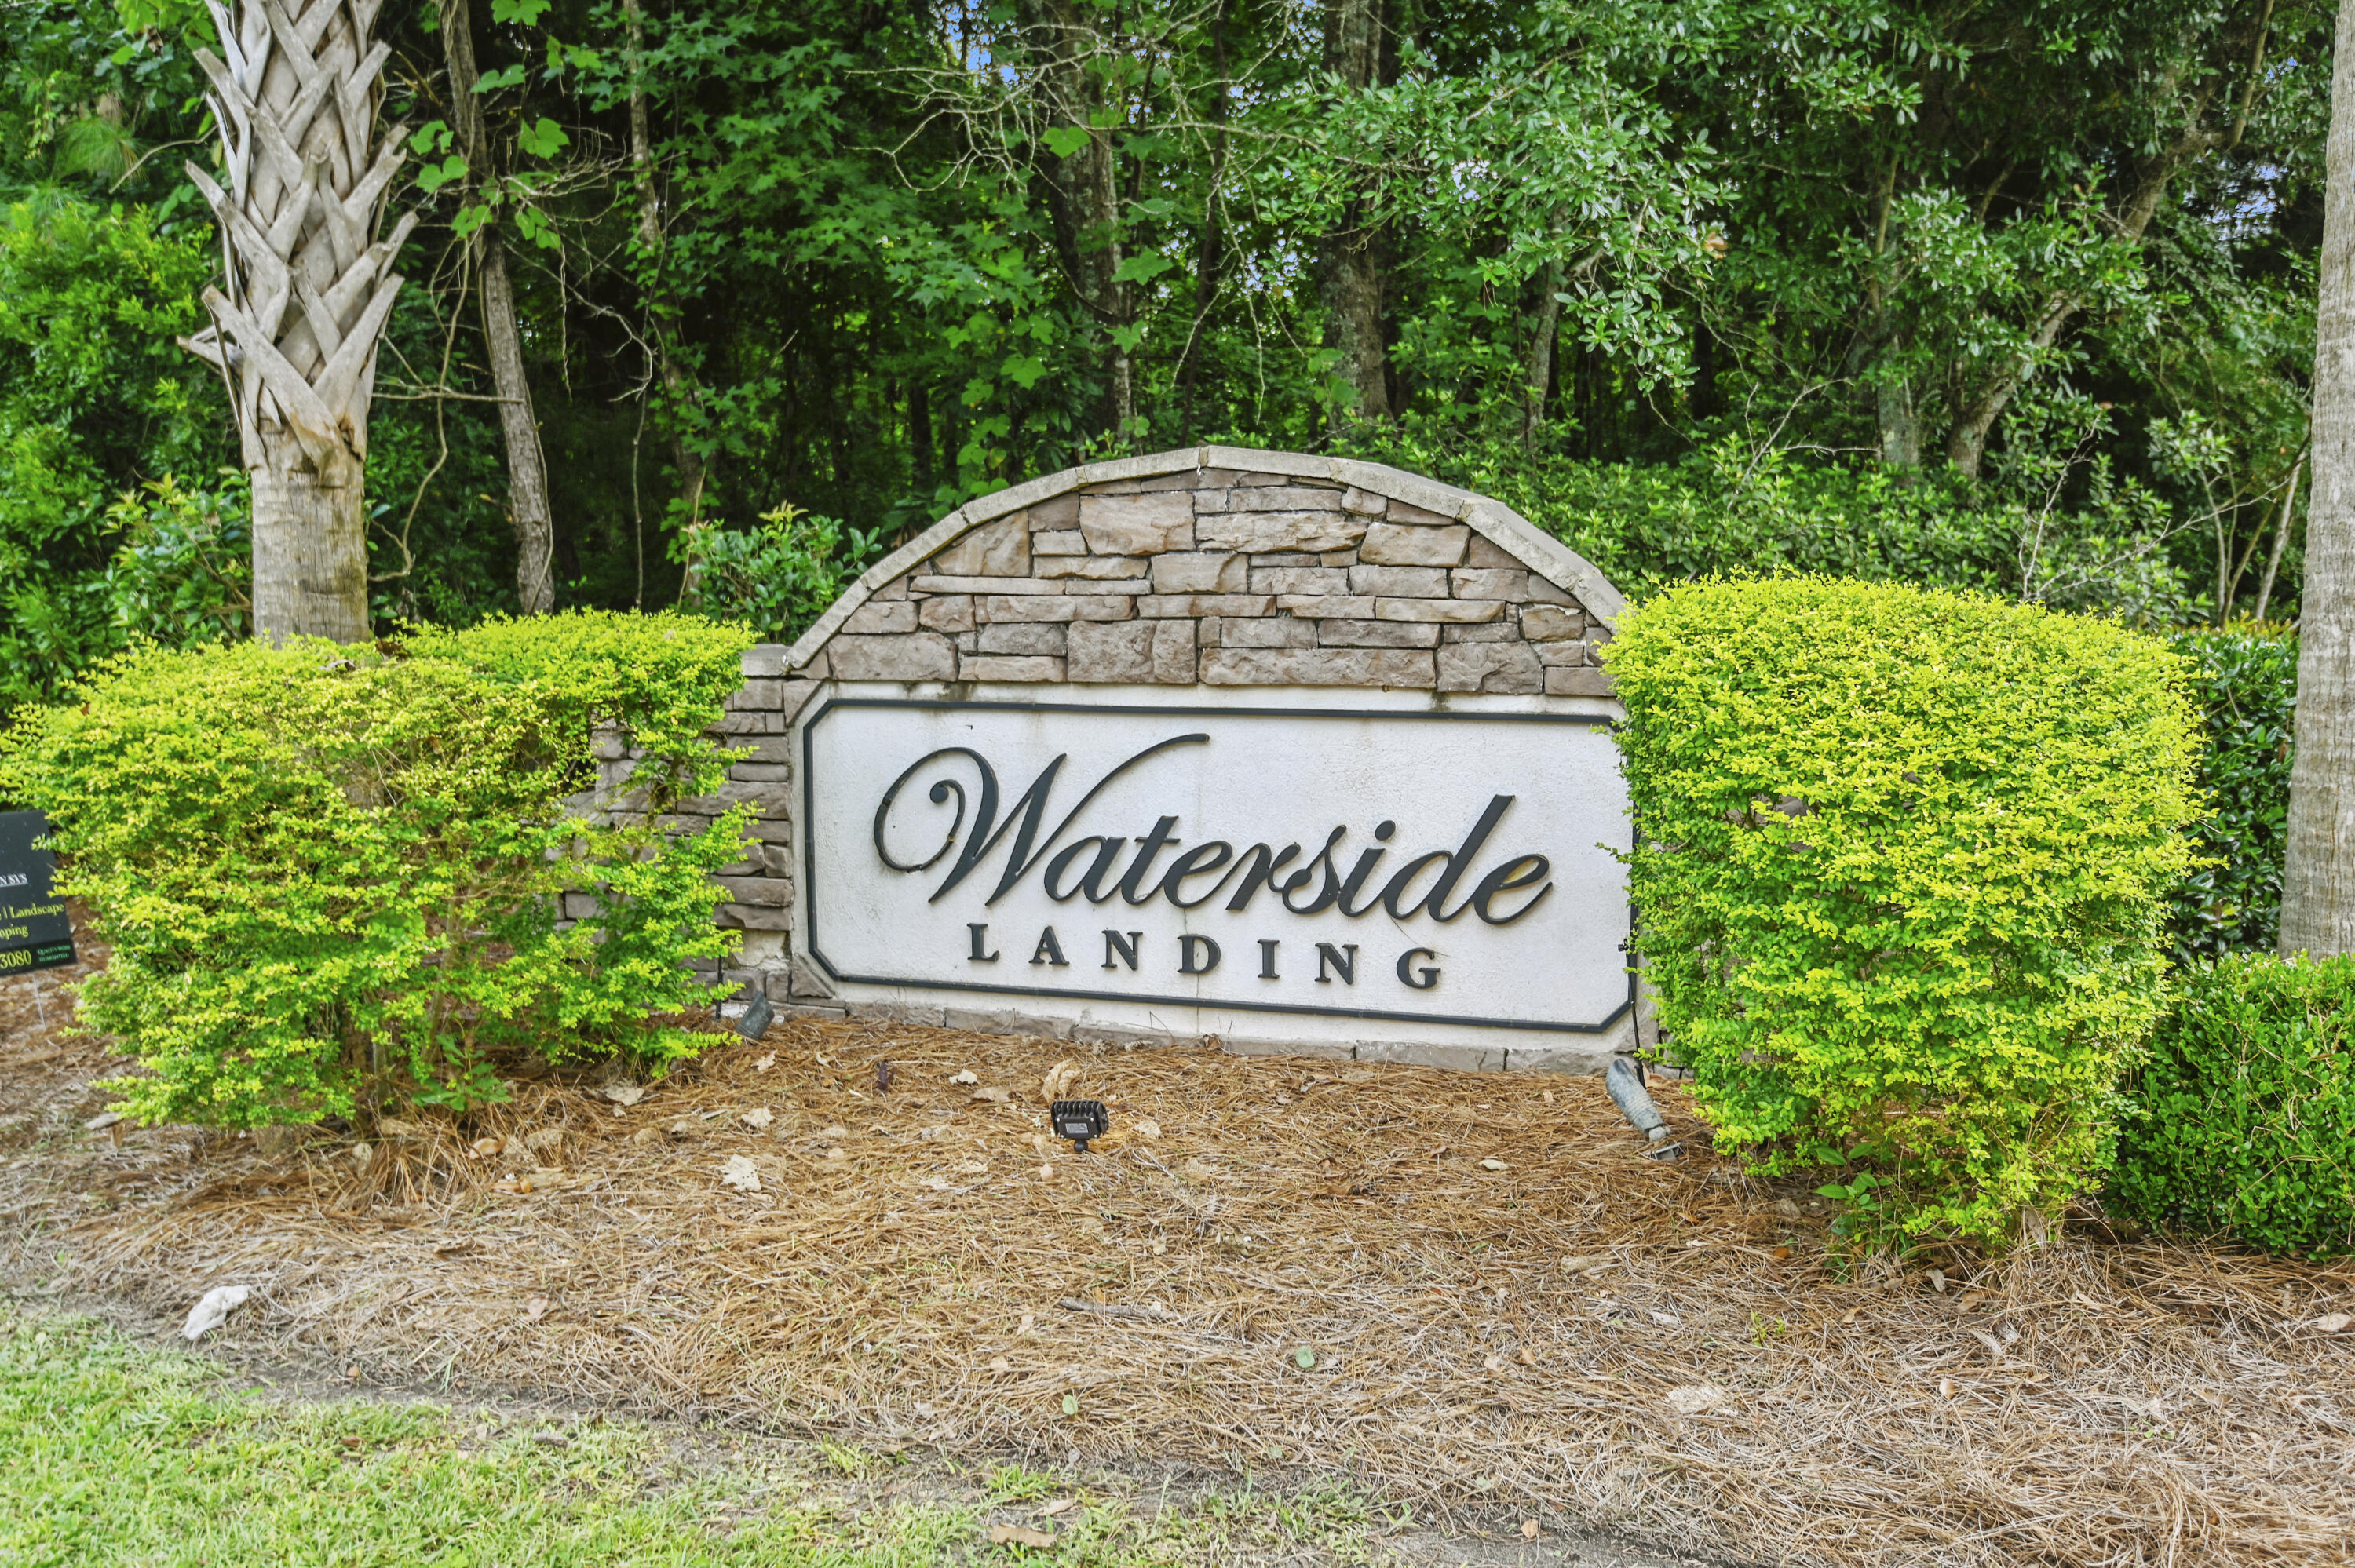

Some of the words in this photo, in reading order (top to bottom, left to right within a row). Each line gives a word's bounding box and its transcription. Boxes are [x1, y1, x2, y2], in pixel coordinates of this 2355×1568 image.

[874, 733, 1554, 927] Waterside
[9, 903, 64, 918] Landscape
[0, 949, 32, 968] 3080
[966, 923, 1442, 990] LANDING
